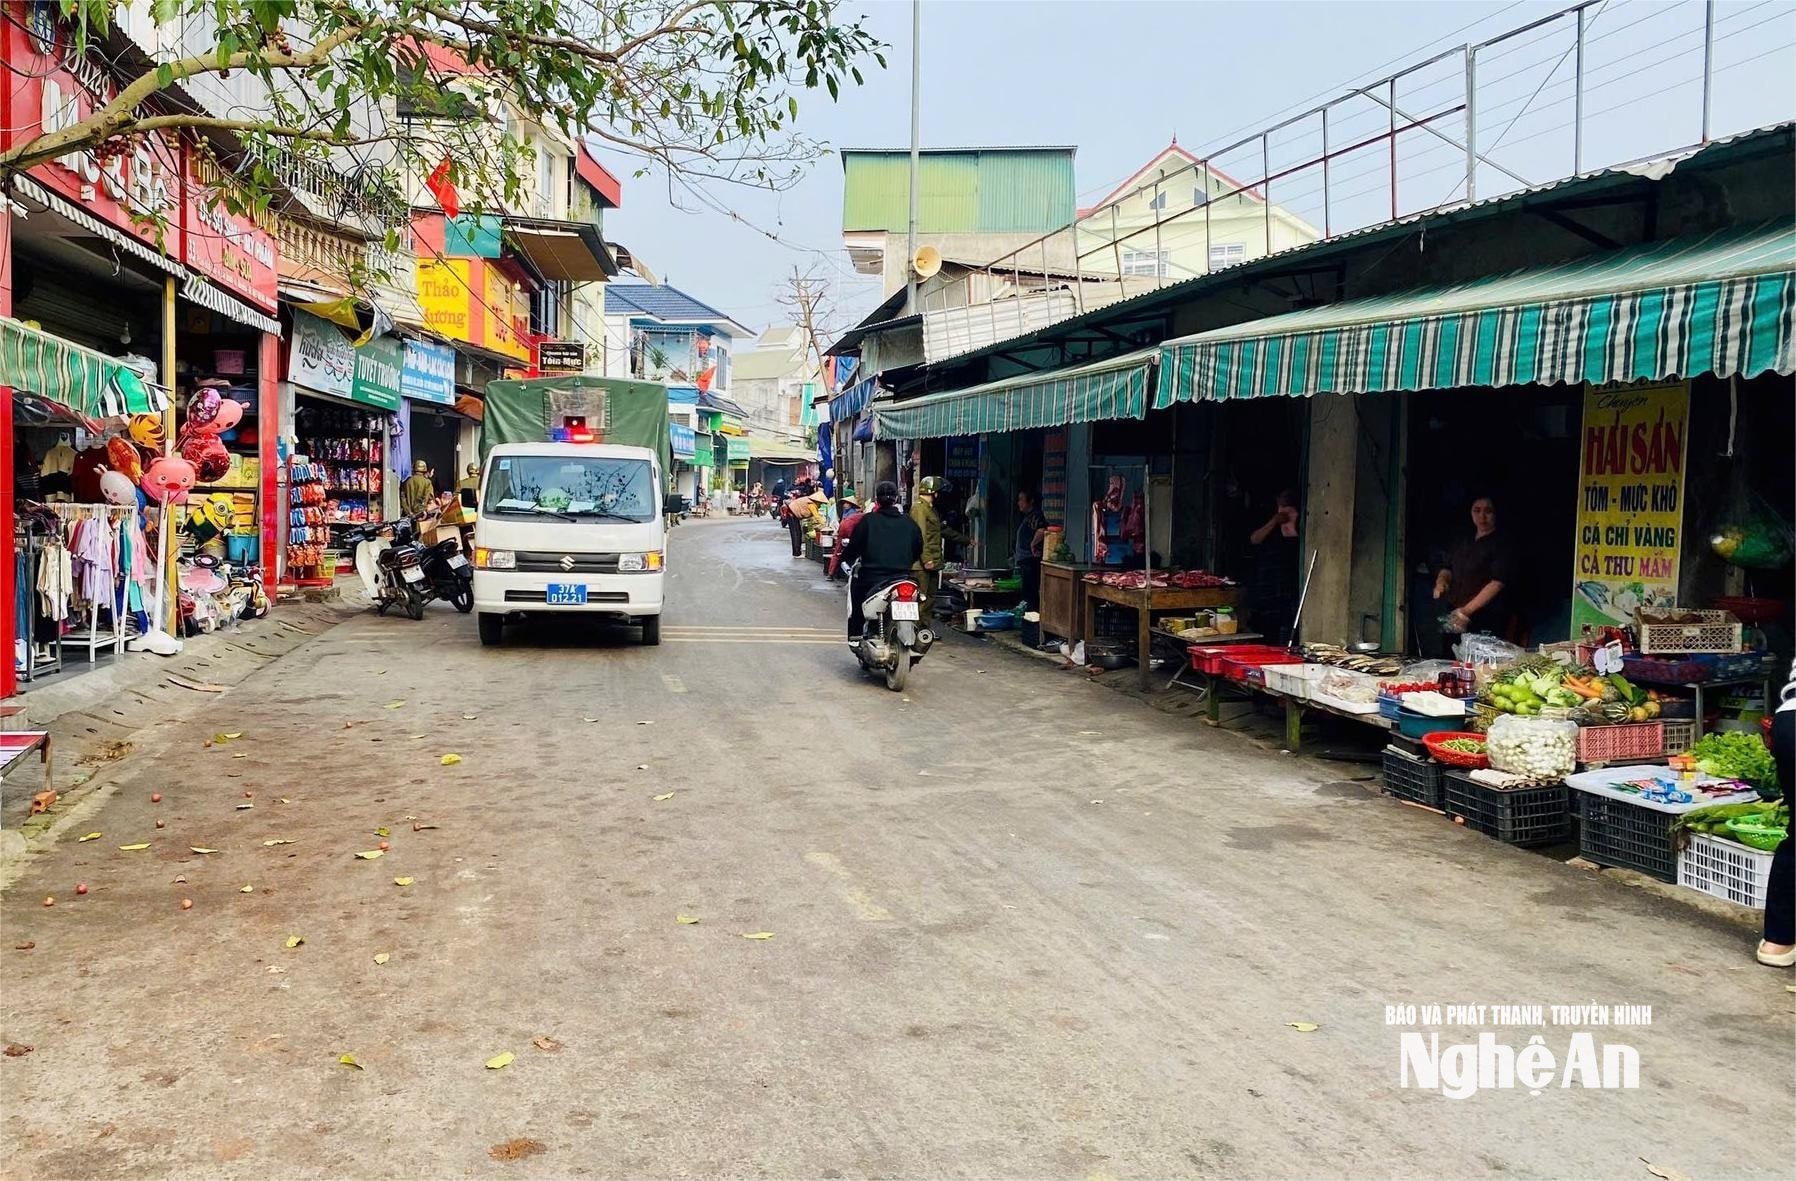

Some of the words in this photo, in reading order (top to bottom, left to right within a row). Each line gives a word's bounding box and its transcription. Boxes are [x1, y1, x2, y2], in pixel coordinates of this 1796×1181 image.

[422, 278, 460, 298] Thảo
[1620, 483, 1649, 518] MỰC
[1651, 479, 1678, 513] KHÔ
[1582, 522, 1600, 546] CÁ
[1605, 519, 1630, 547] CHỈ
[1634, 522, 1676, 548] VÀNG
[1604, 555, 1634, 577] THU
[558, 584, 576, 594] 37A
